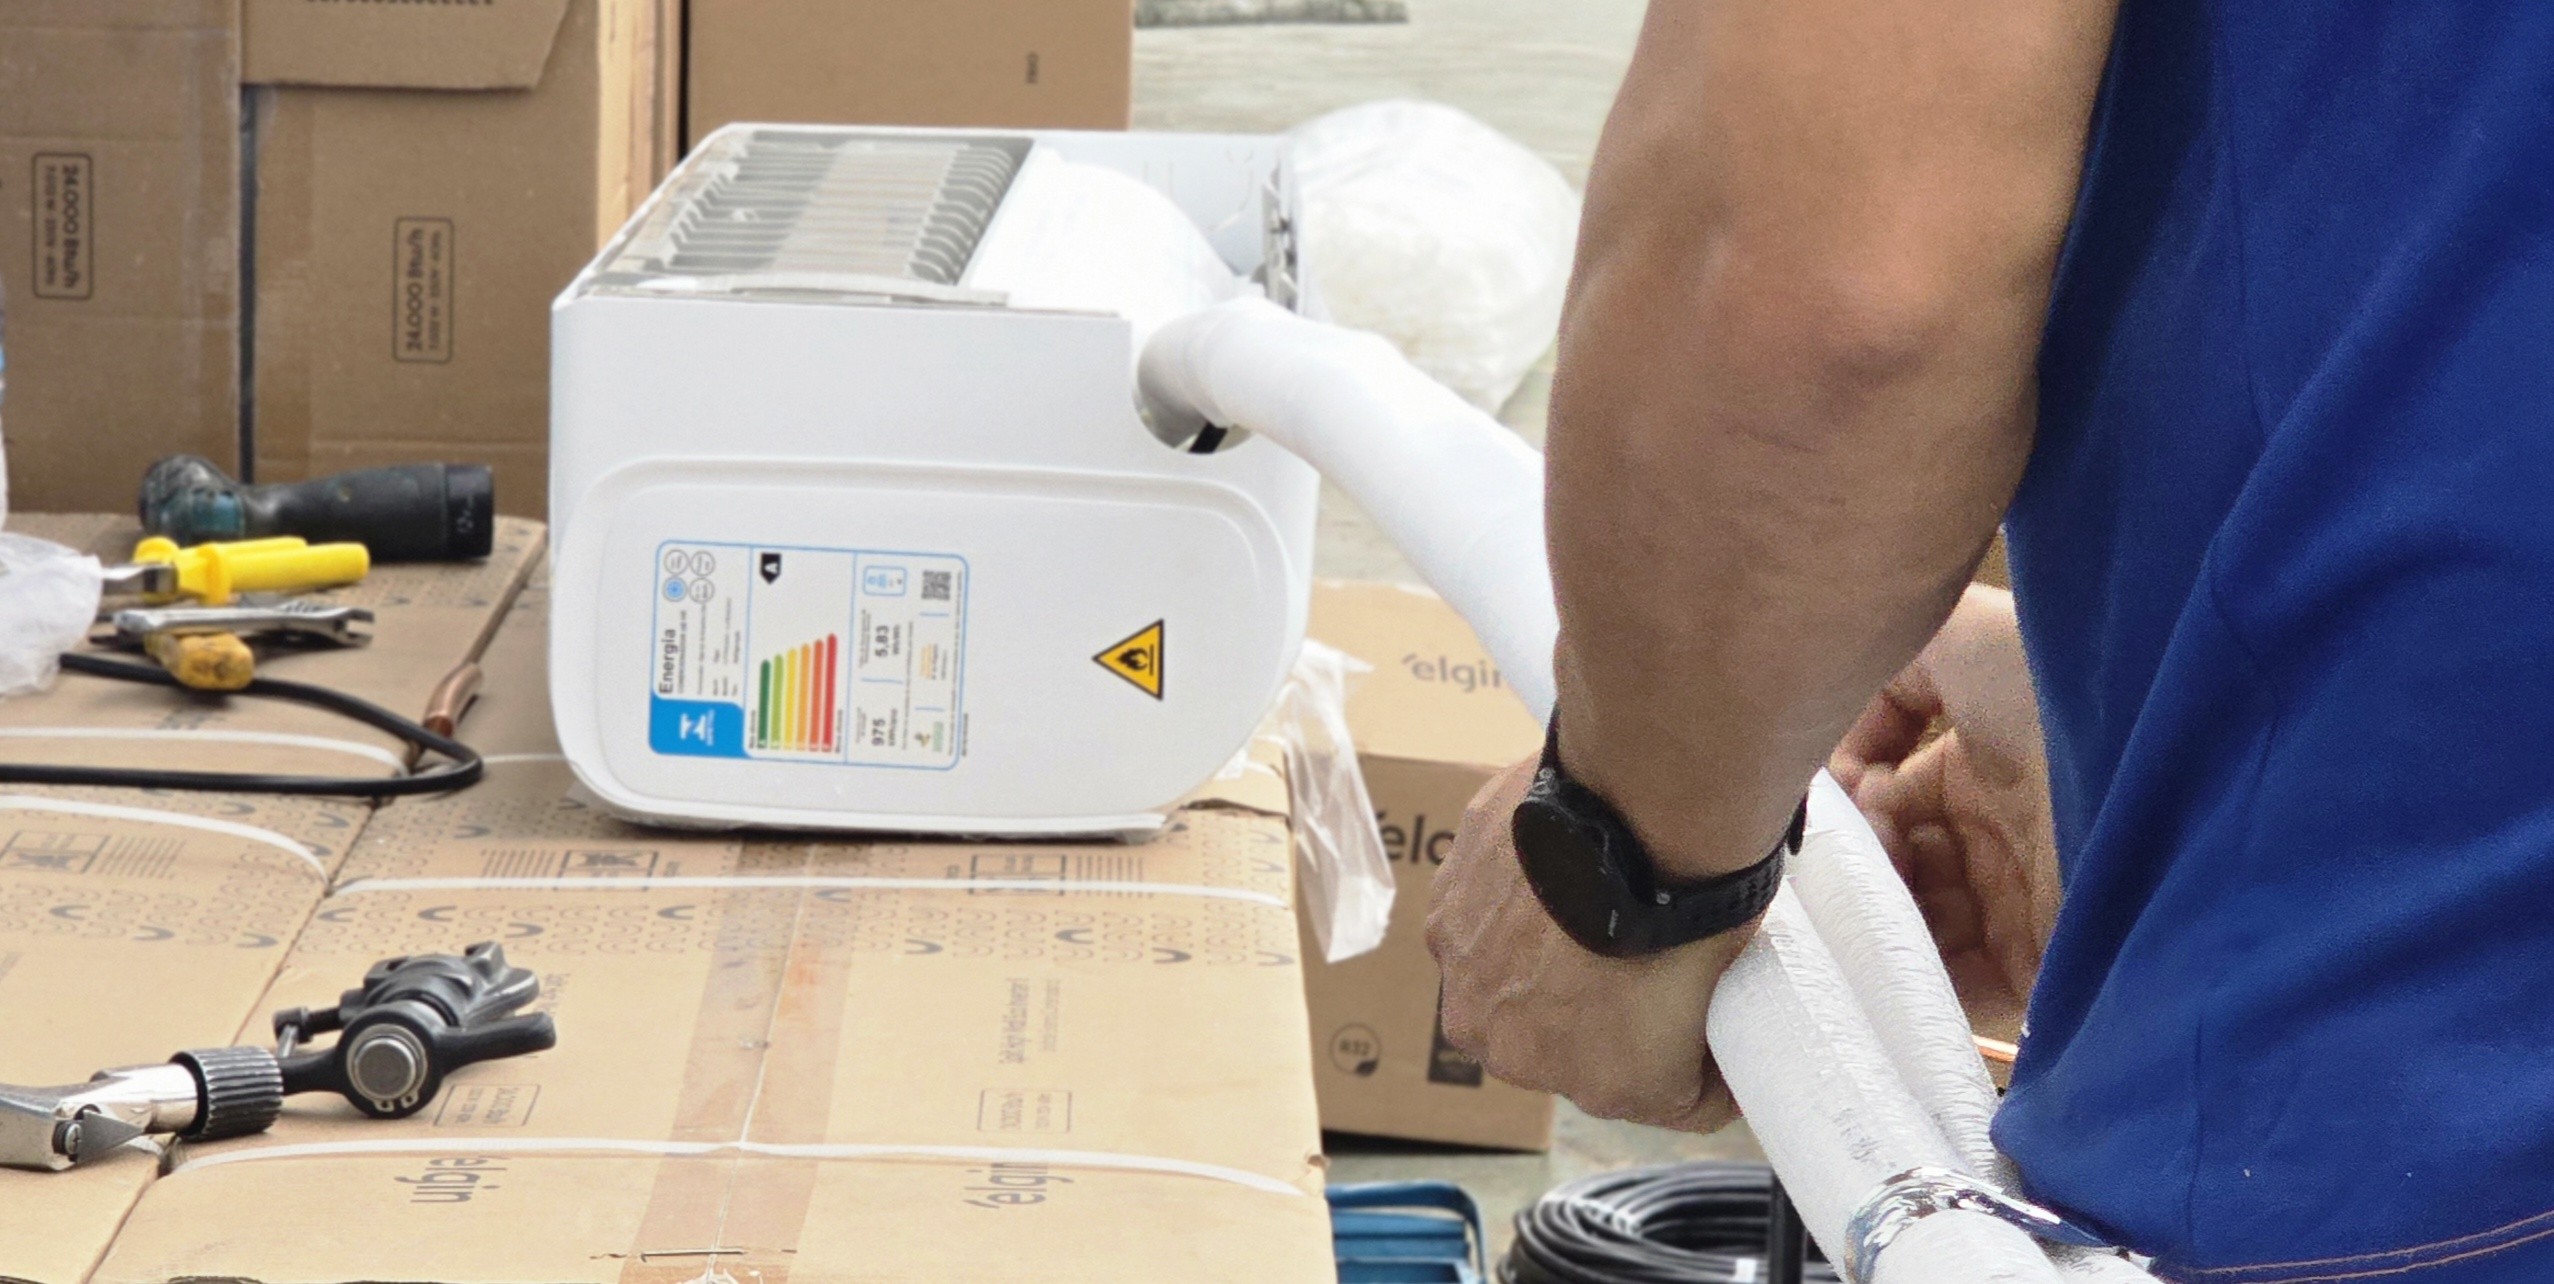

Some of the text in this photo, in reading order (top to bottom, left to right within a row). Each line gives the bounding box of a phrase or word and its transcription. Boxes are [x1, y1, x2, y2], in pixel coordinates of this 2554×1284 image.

[875, 624, 890, 658] 5,83
[658, 628, 680, 695] Energia
[871, 717, 886, 746] 975
